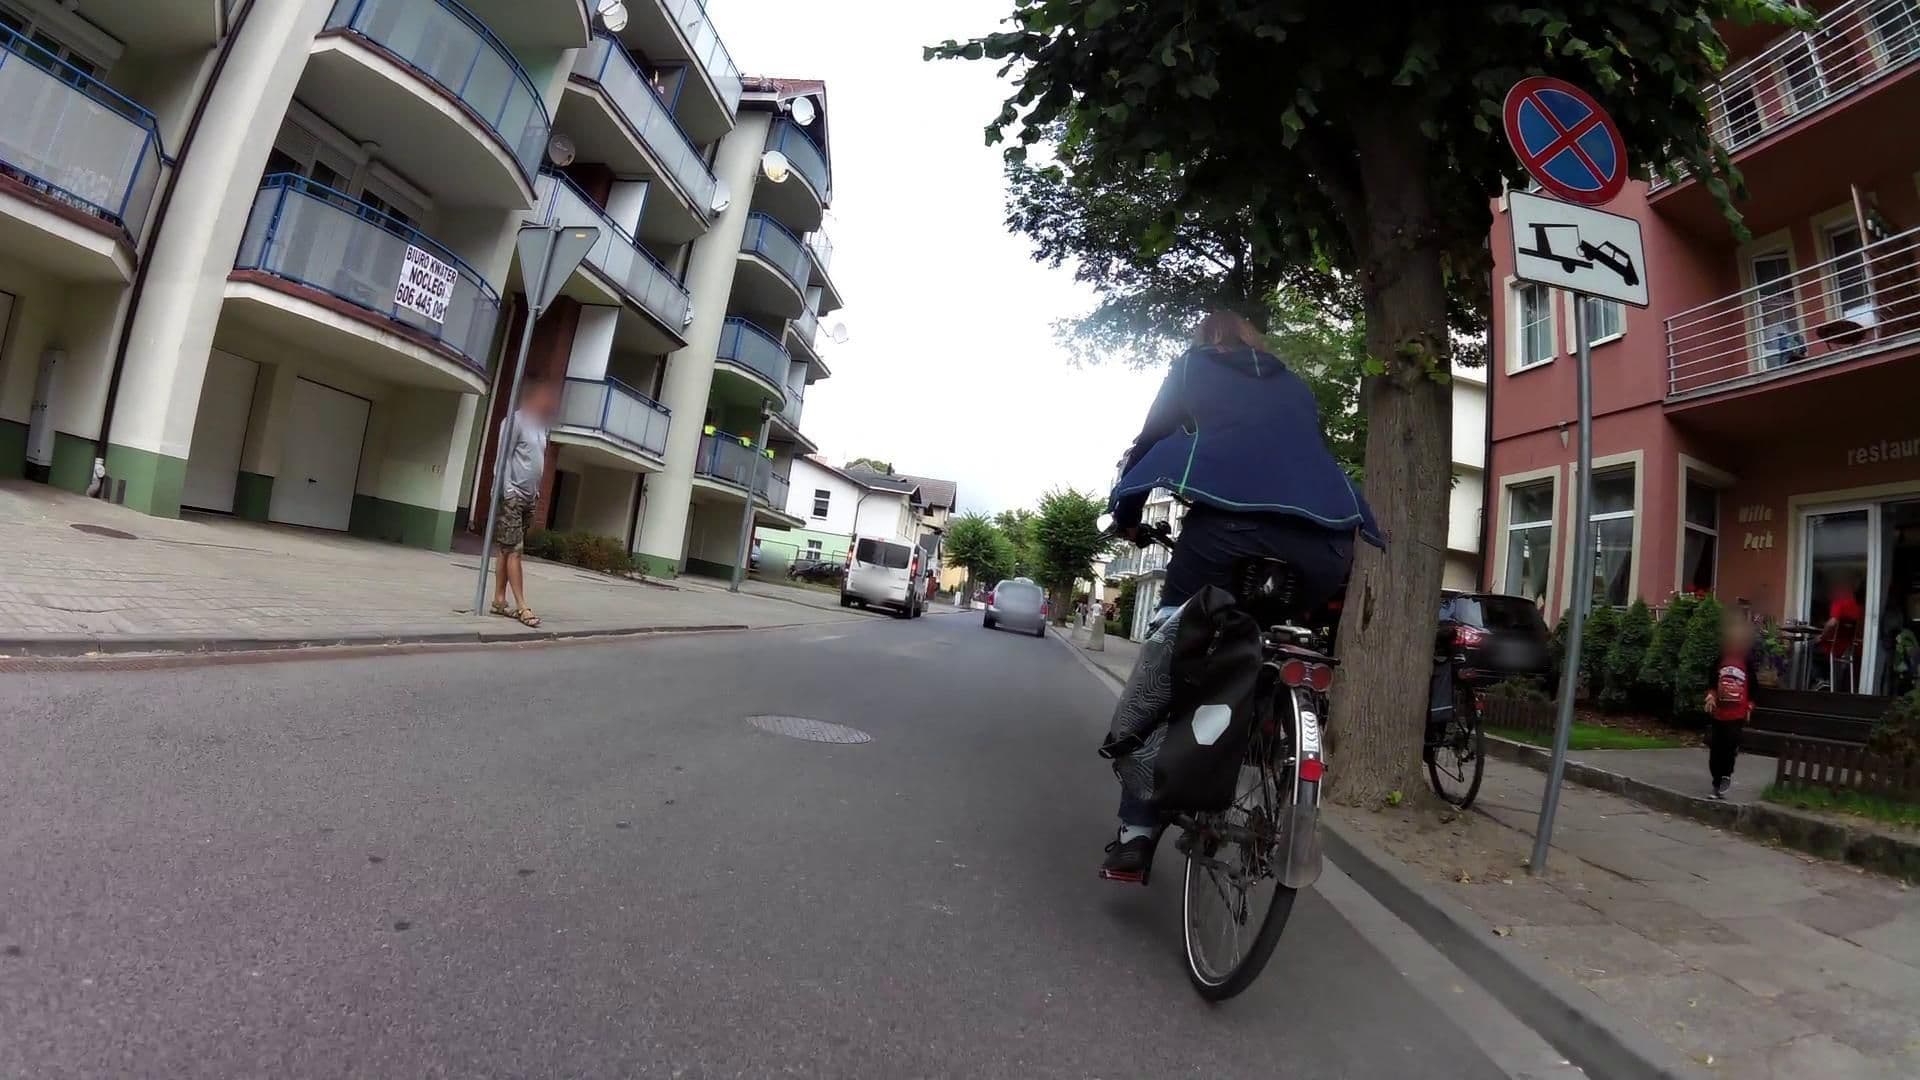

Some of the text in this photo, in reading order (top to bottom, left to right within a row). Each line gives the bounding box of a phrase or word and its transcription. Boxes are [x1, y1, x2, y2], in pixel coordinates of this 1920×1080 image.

[406, 247, 457, 285] BIURO KWATER
[409, 266, 446, 298] NOCLEGI
[396, 283, 448, 321] 606 445 091
[1743, 530, 1774, 550] Park
